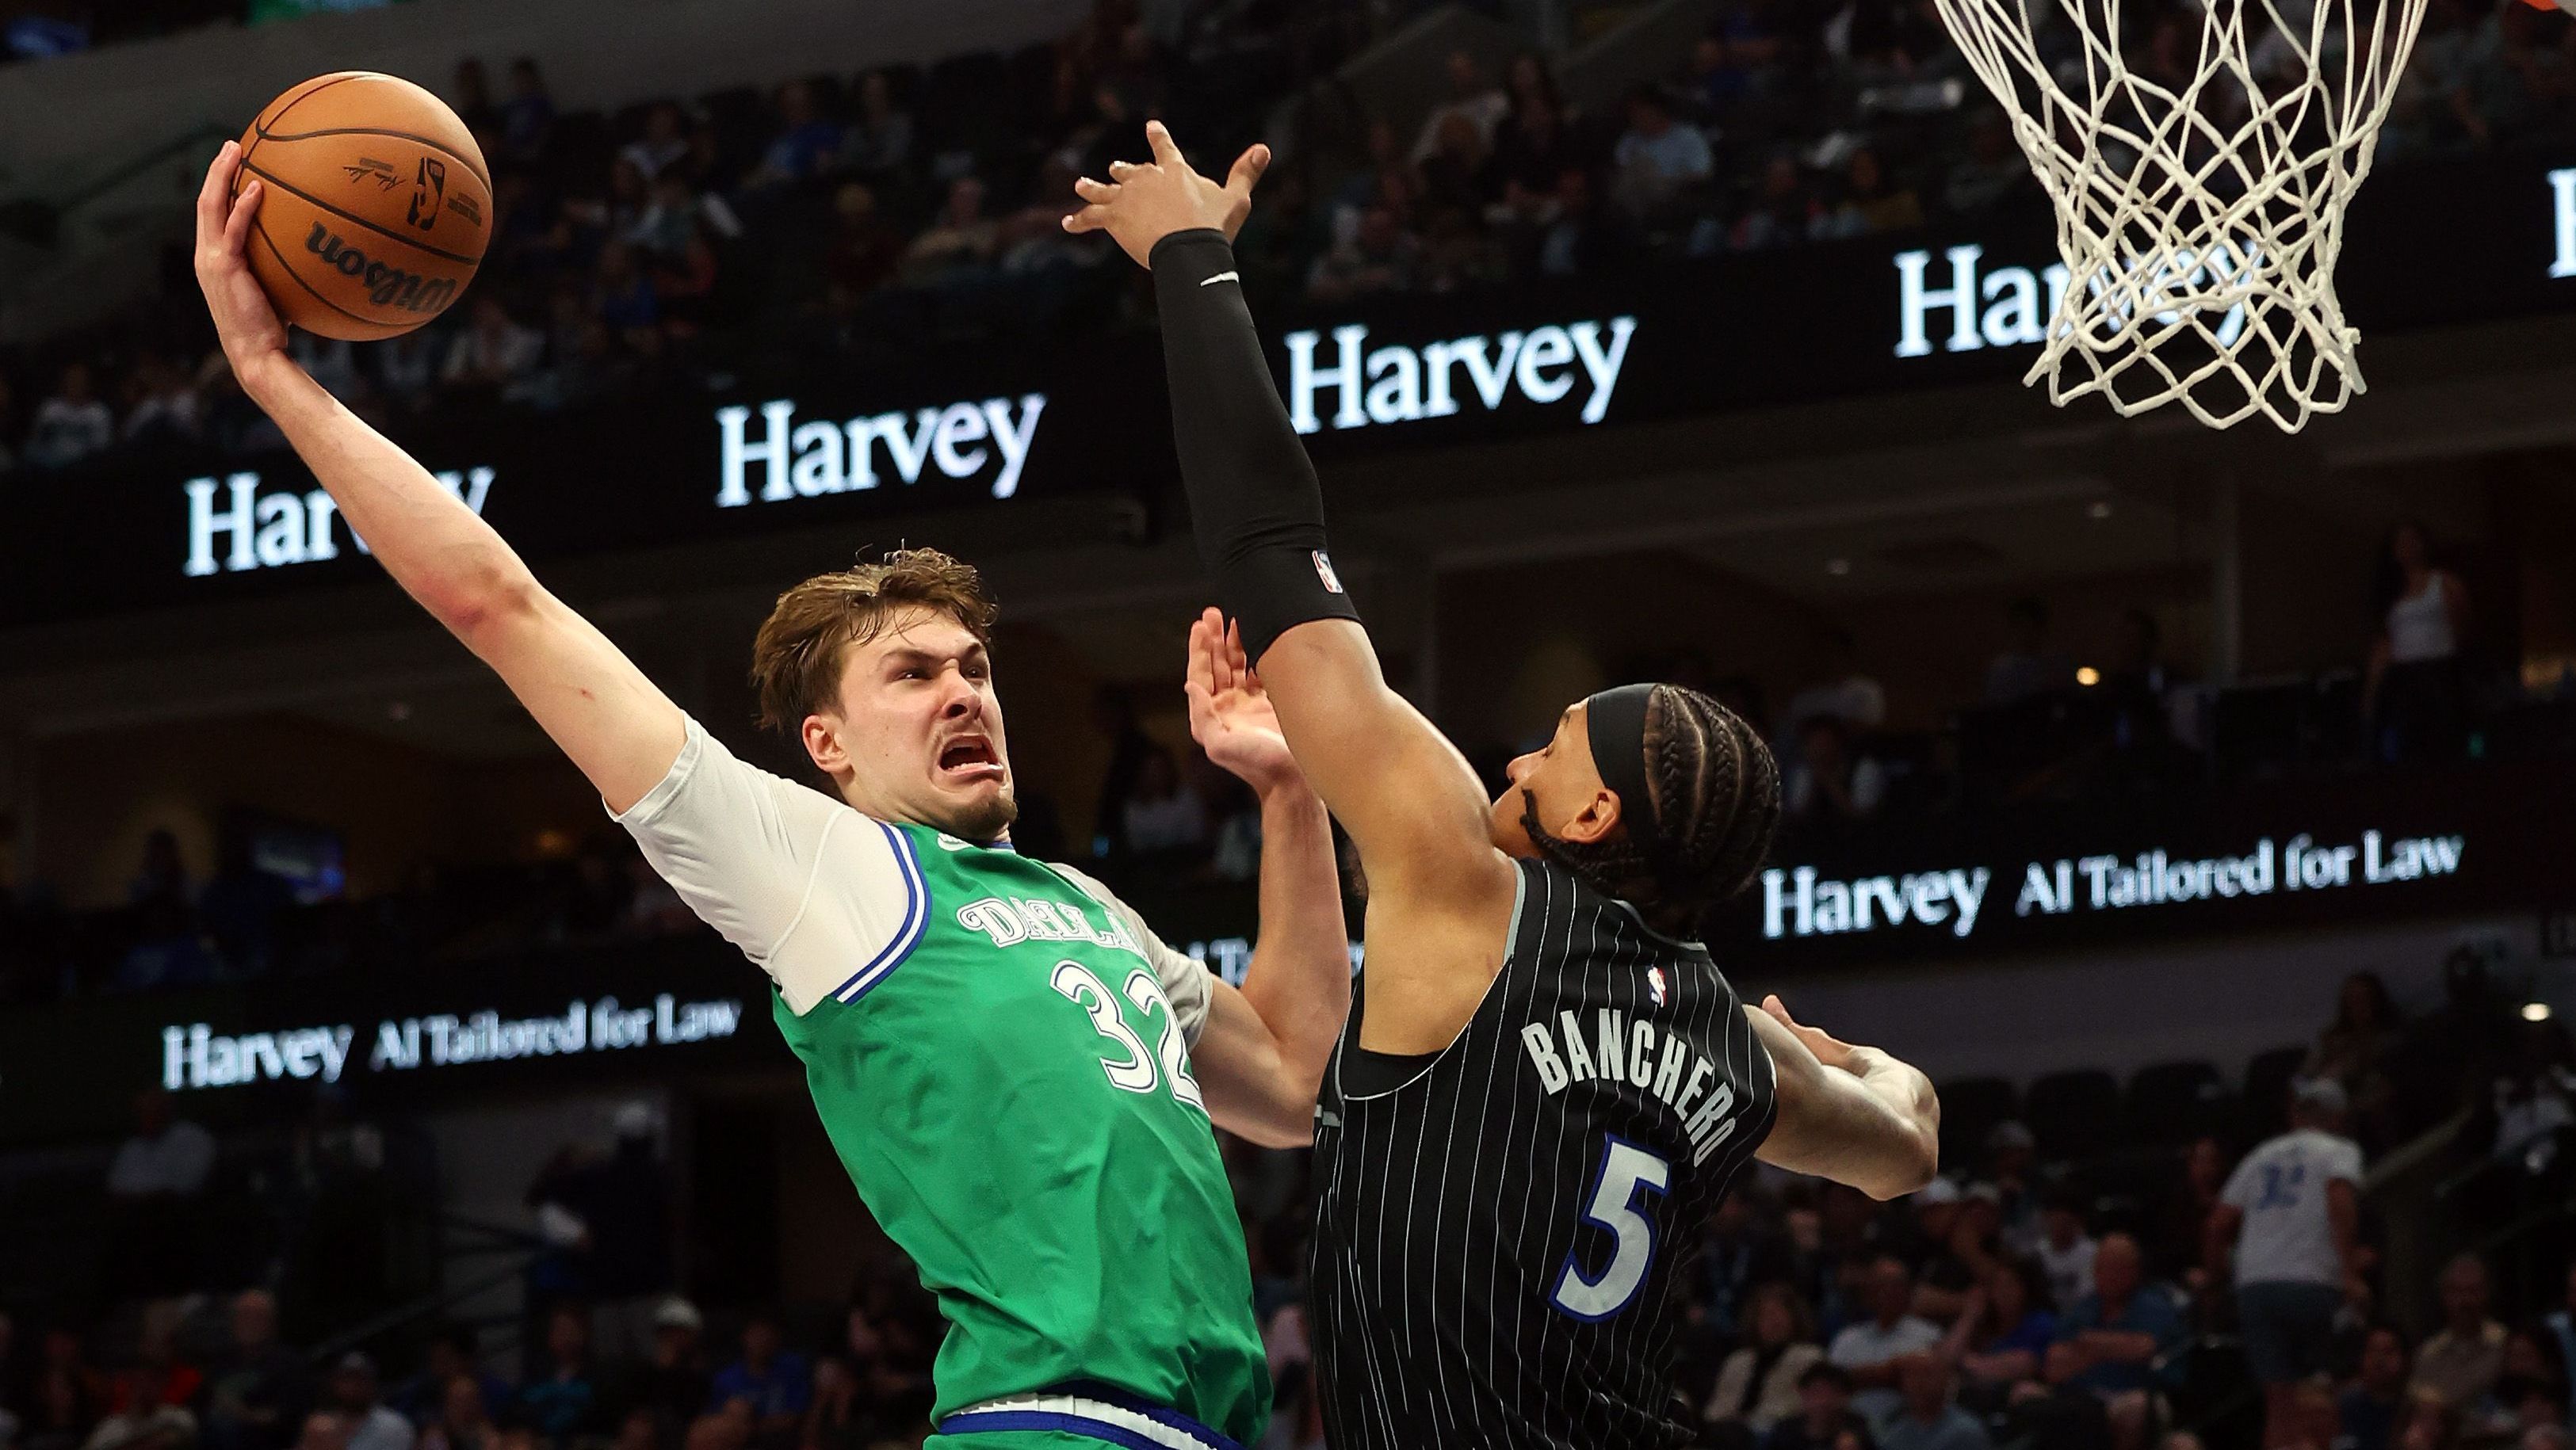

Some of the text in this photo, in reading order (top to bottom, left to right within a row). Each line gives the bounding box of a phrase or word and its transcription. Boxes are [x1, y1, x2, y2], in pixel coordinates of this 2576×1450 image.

[304, 220, 457, 313] Wilson
[1283, 315, 1638, 435] Harvey
[715, 392, 1048, 508] Harvey
[1761, 829, 2463, 939] Harvey AI Tailored for Law
[162, 1022, 354, 1091] Harvey
[1049, 960, 1206, 1109] 32
[1520, 1007, 1737, 1169] BANCHERO
[1548, 1132, 1672, 1323] 5
